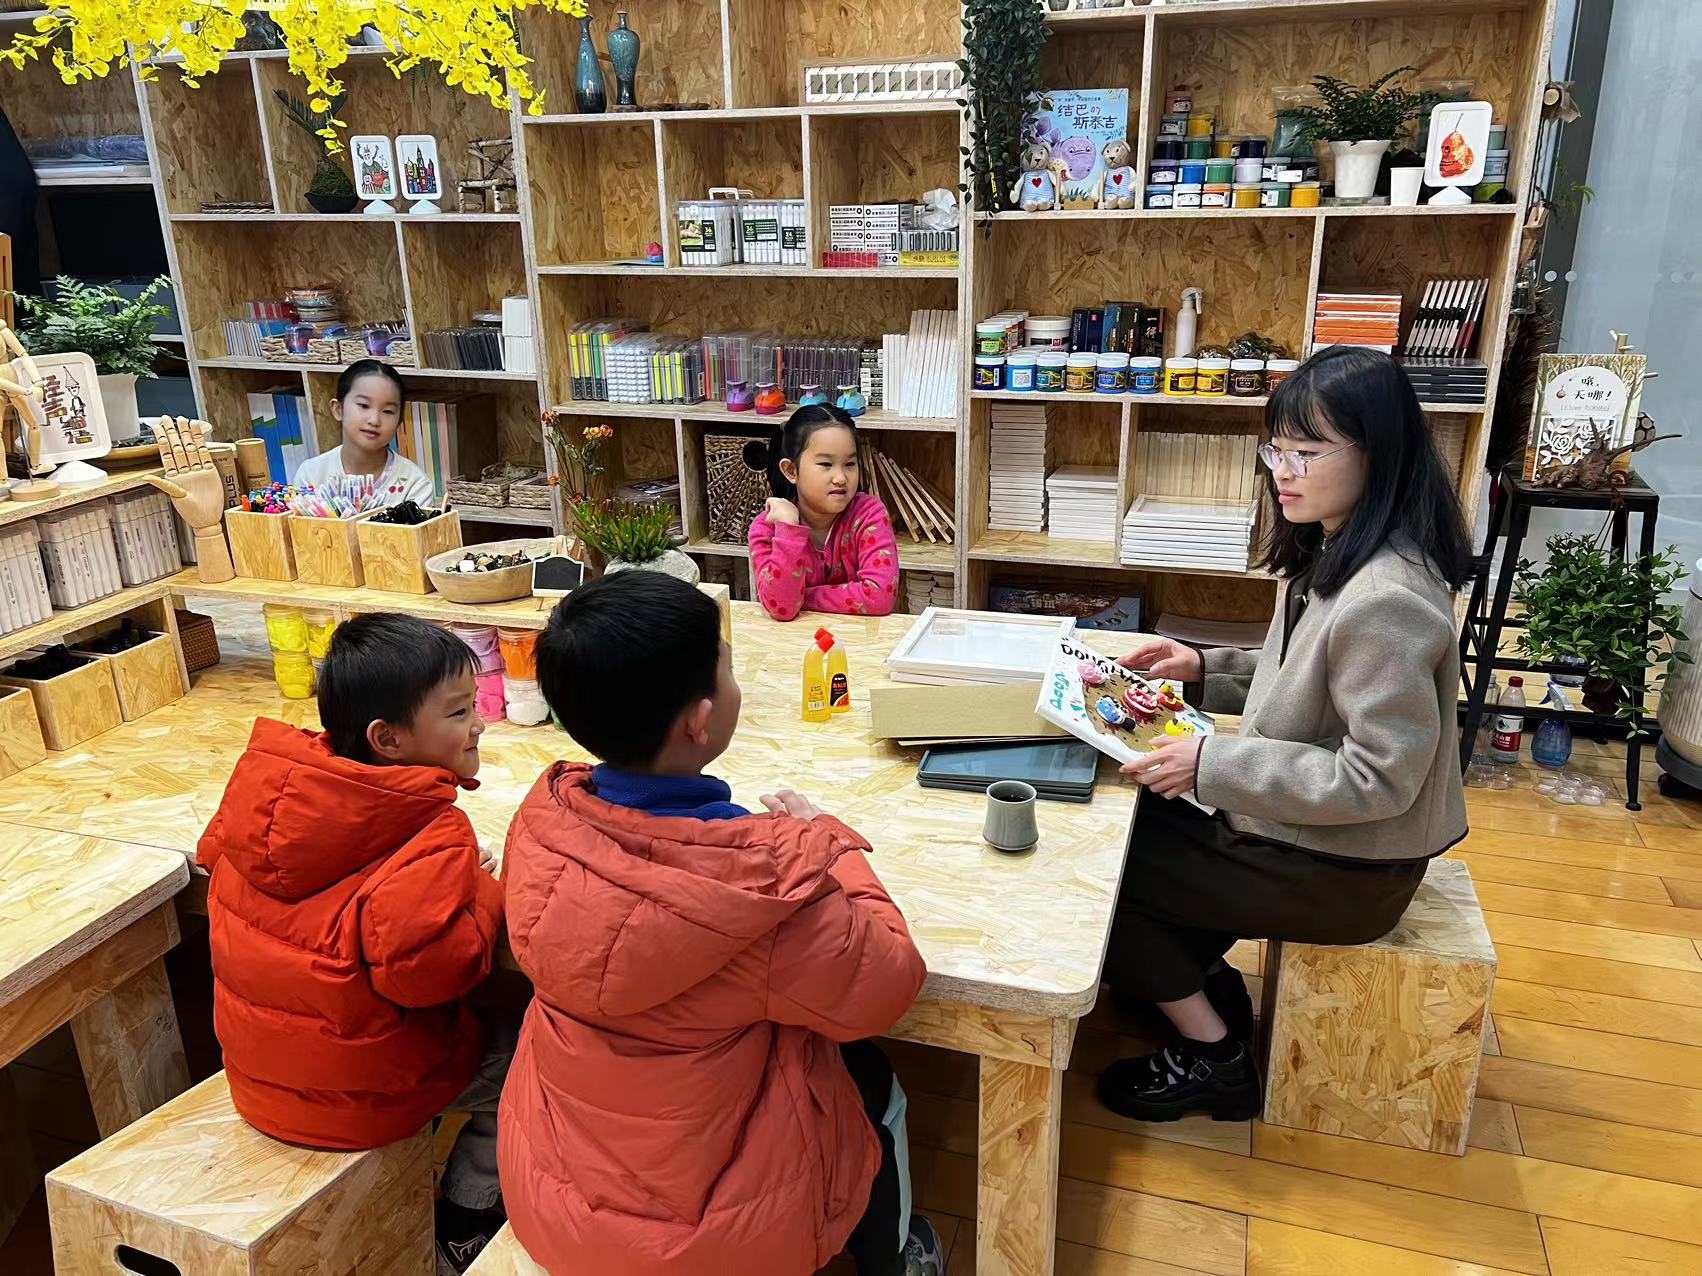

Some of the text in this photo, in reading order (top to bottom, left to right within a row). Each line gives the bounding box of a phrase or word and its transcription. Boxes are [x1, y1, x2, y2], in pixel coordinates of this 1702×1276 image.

[1058, 104, 1101, 117] 结巴的
[1072, 115, 1118, 129] 斯泰吉
[225, 475, 237, 508] PLUS
